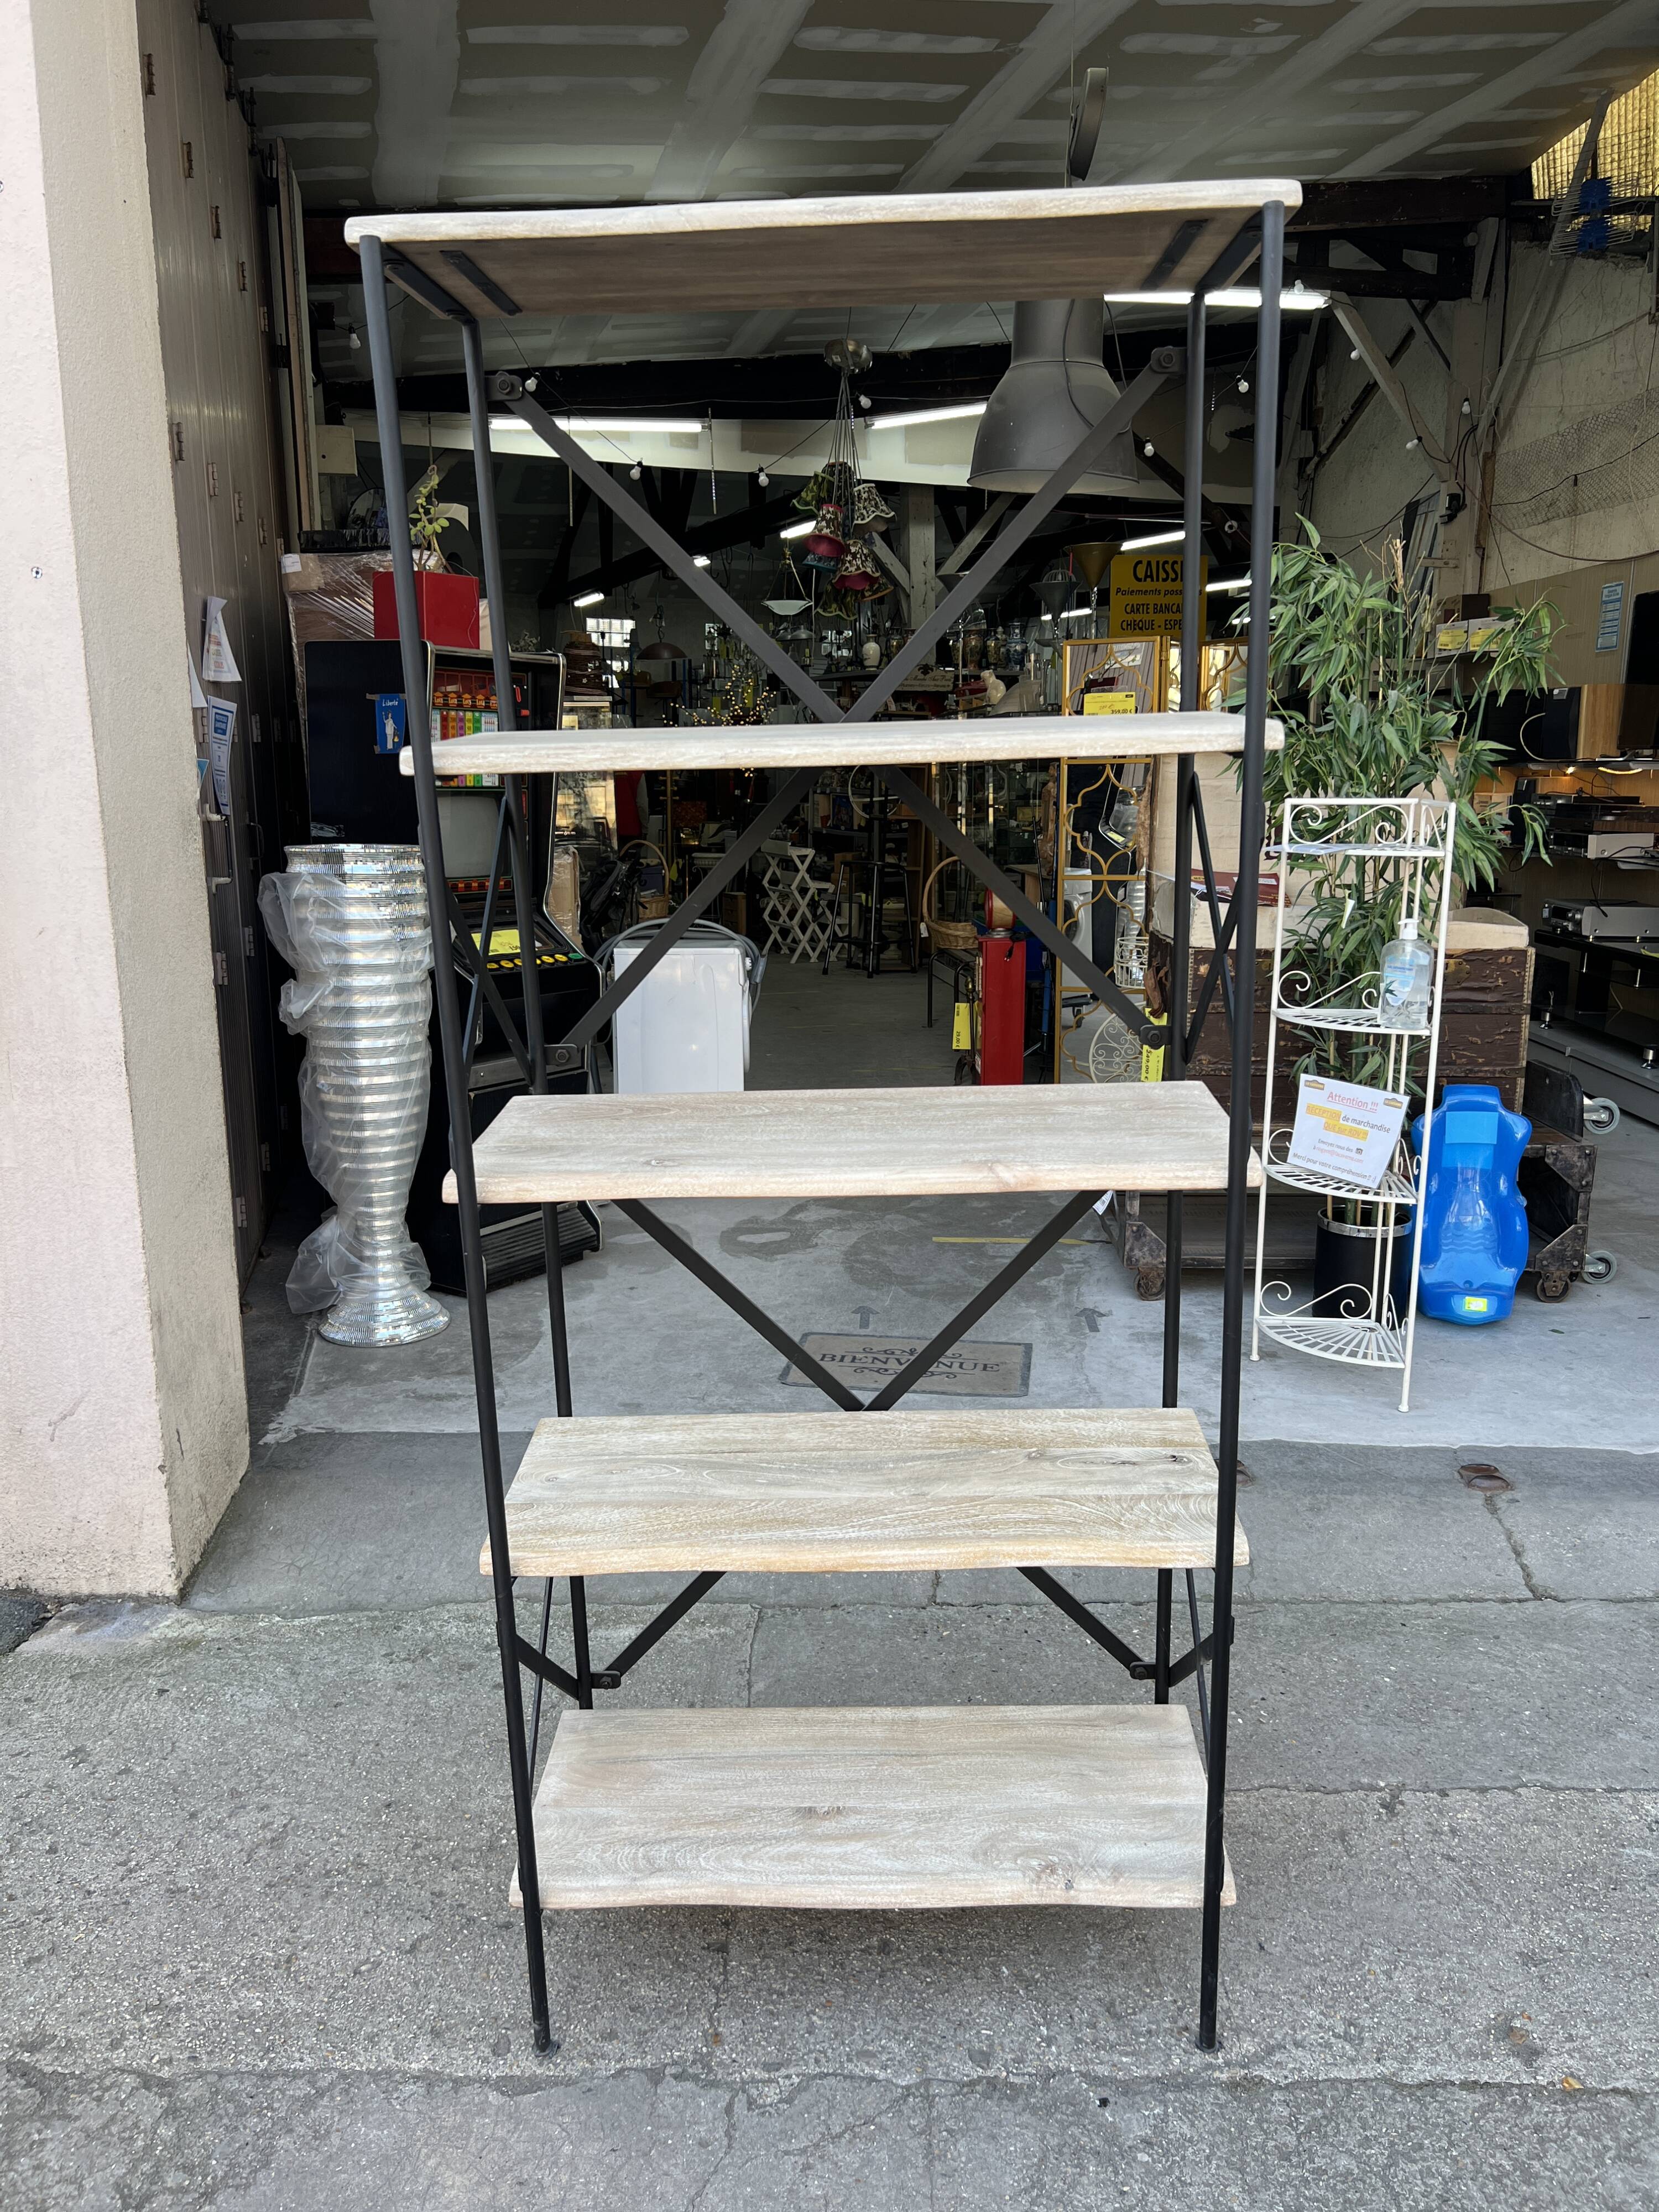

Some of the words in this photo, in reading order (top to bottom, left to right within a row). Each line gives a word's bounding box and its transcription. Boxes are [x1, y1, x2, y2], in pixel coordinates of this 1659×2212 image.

[1115, 587, 1161, 596] Paiements
[1164, 589, 1202, 598] posss
[1124, 603, 1150, 614] CARTE
[1153, 603, 1183, 614] BANCAI
[1120, 619, 1155, 631] CHEQUE
[1164, 619, 1182, 630] ESPE
[1327, 1092, 1368, 1109] Attention
[1351, 1118, 1391, 1133] marchandise
[1318, 1139, 1334, 1147] Envoyez
[1292, 1152, 1306, 1161] Merci
[1318, 1160, 1332, 1168] votre
[1332, 1165, 1367, 1180] compréhension
[819, 1353, 1001, 1372] BIENVNUE
